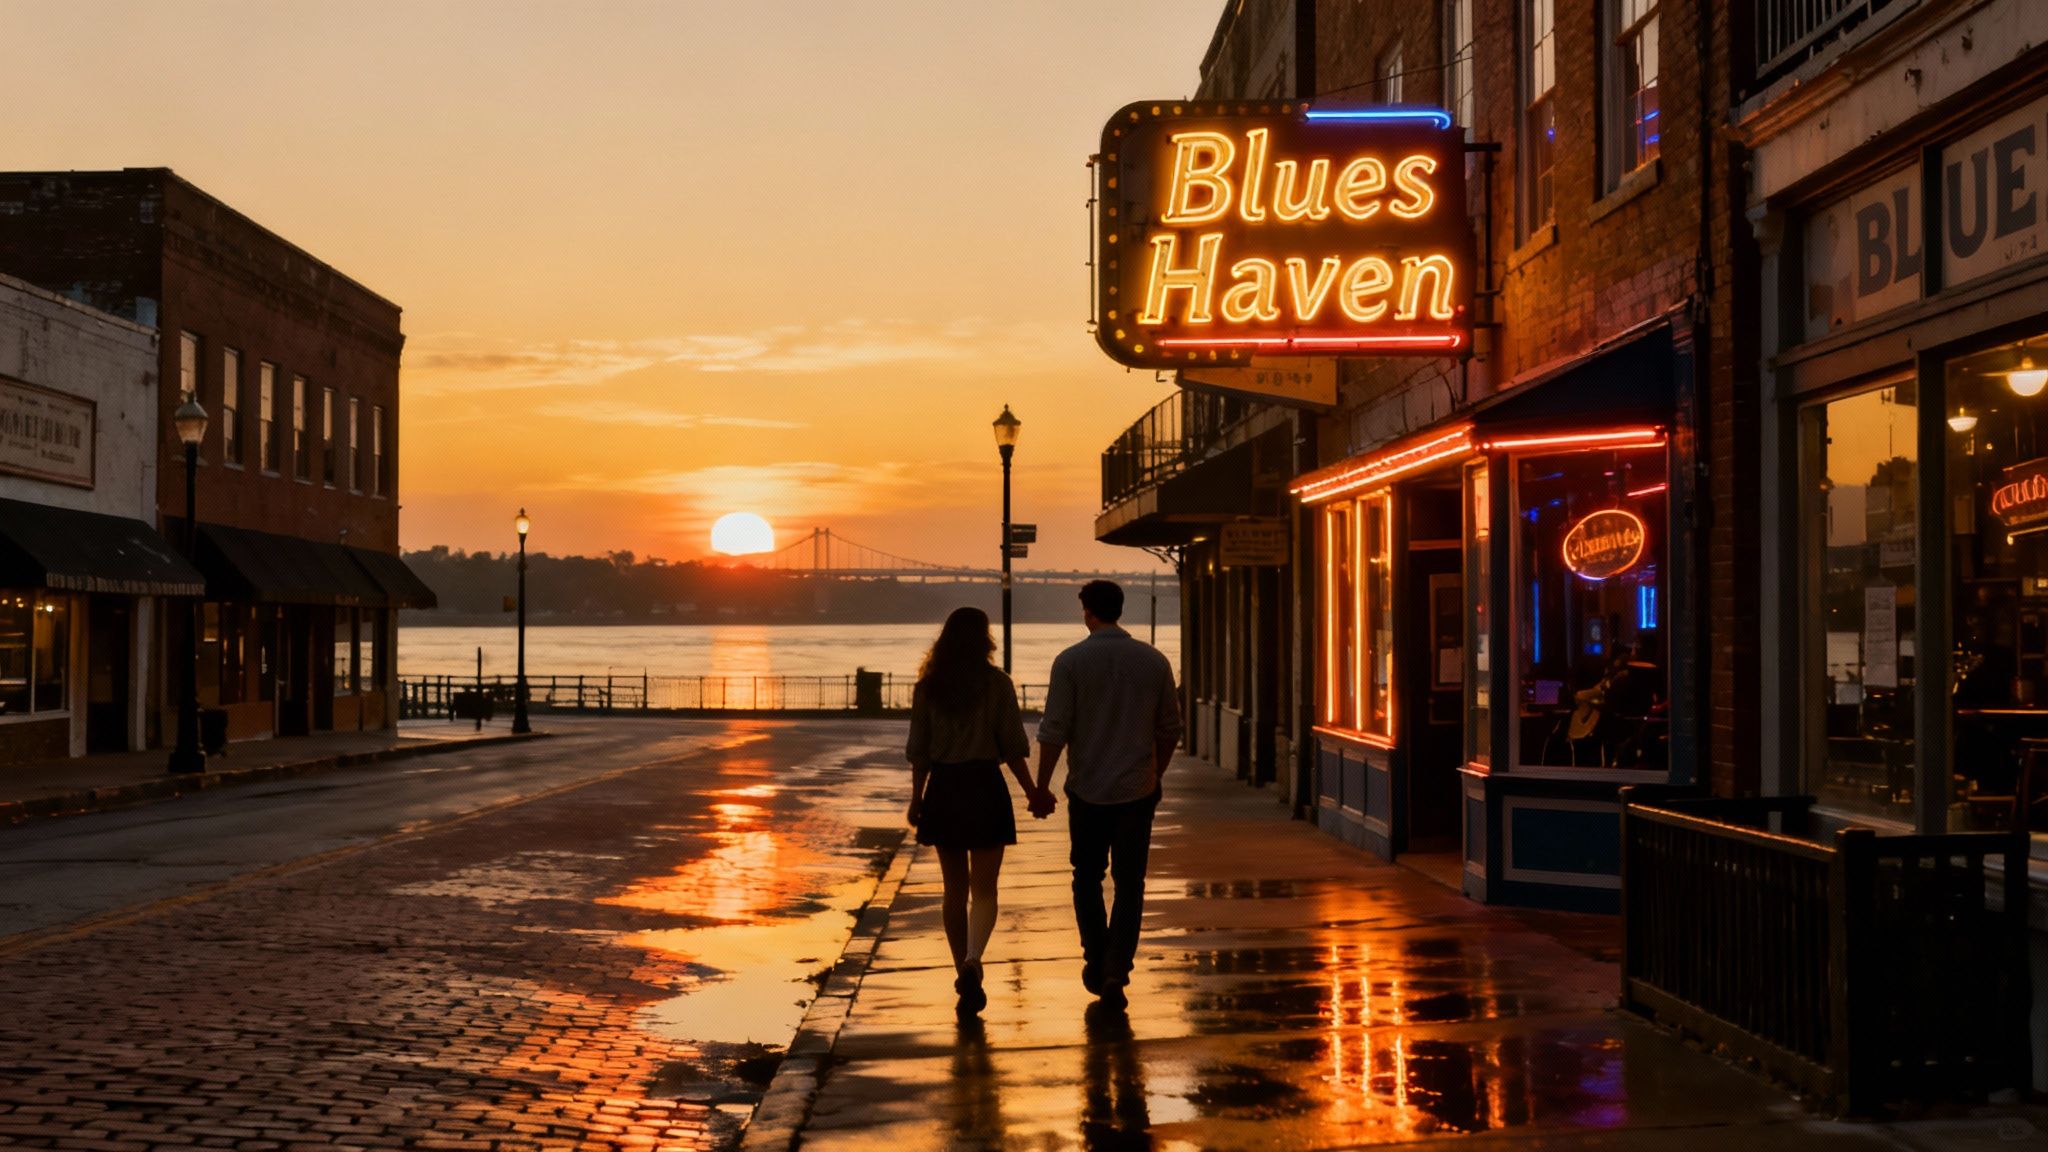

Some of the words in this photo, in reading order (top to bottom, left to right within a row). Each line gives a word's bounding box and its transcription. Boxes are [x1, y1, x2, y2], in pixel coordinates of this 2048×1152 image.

[1160, 127, 1438, 224] Blues
[1856, 113, 2048, 298] BLUE
[1137, 232, 1456, 325] Haven
